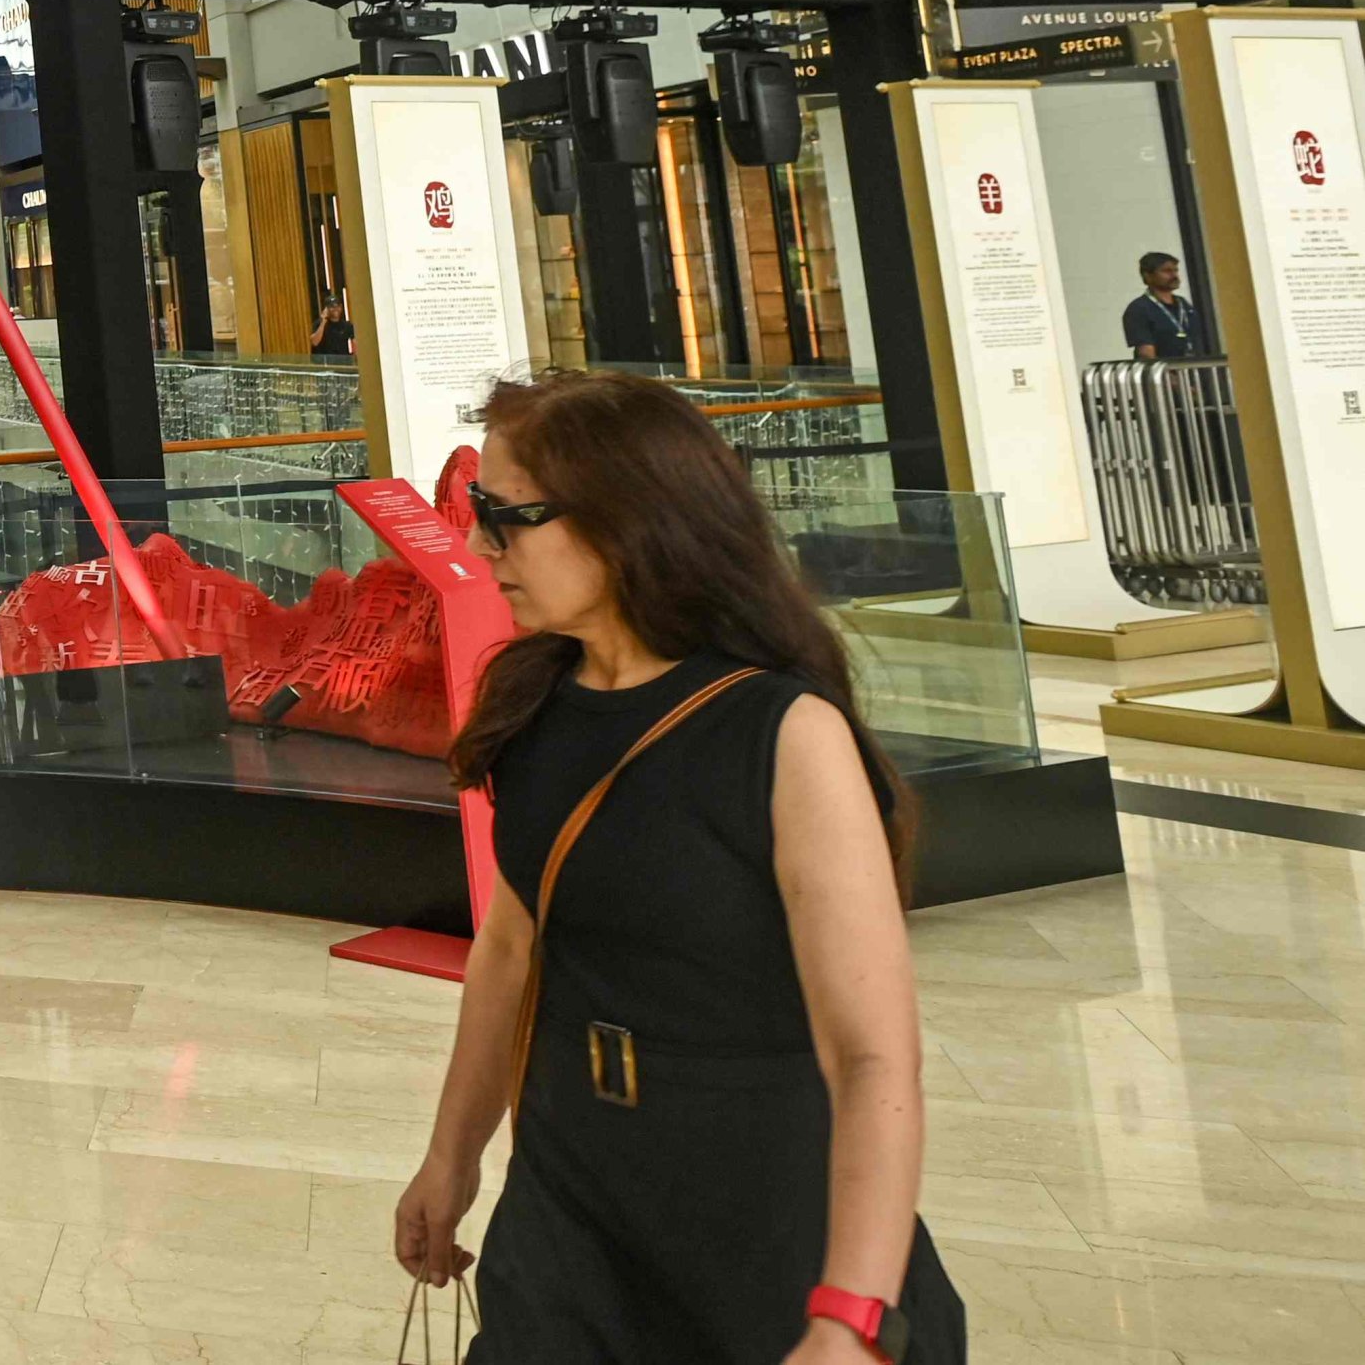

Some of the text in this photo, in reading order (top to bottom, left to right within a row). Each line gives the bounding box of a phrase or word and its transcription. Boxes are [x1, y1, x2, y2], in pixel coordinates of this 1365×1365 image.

[1021, 12, 1087, 25] AVENUE
[963, 53, 996, 69] EVENT
[999, 47, 1038, 61] PLAZA
[1059, 36, 1123, 54] SPECTRA
[1295, 137, 1326, 179] 蛇
[426, 187, 453, 225] 鸡
[979, 177, 1002, 211] 羊
[43, 563, 73, 585] 顺
[73, 559, 111, 586] 吉
